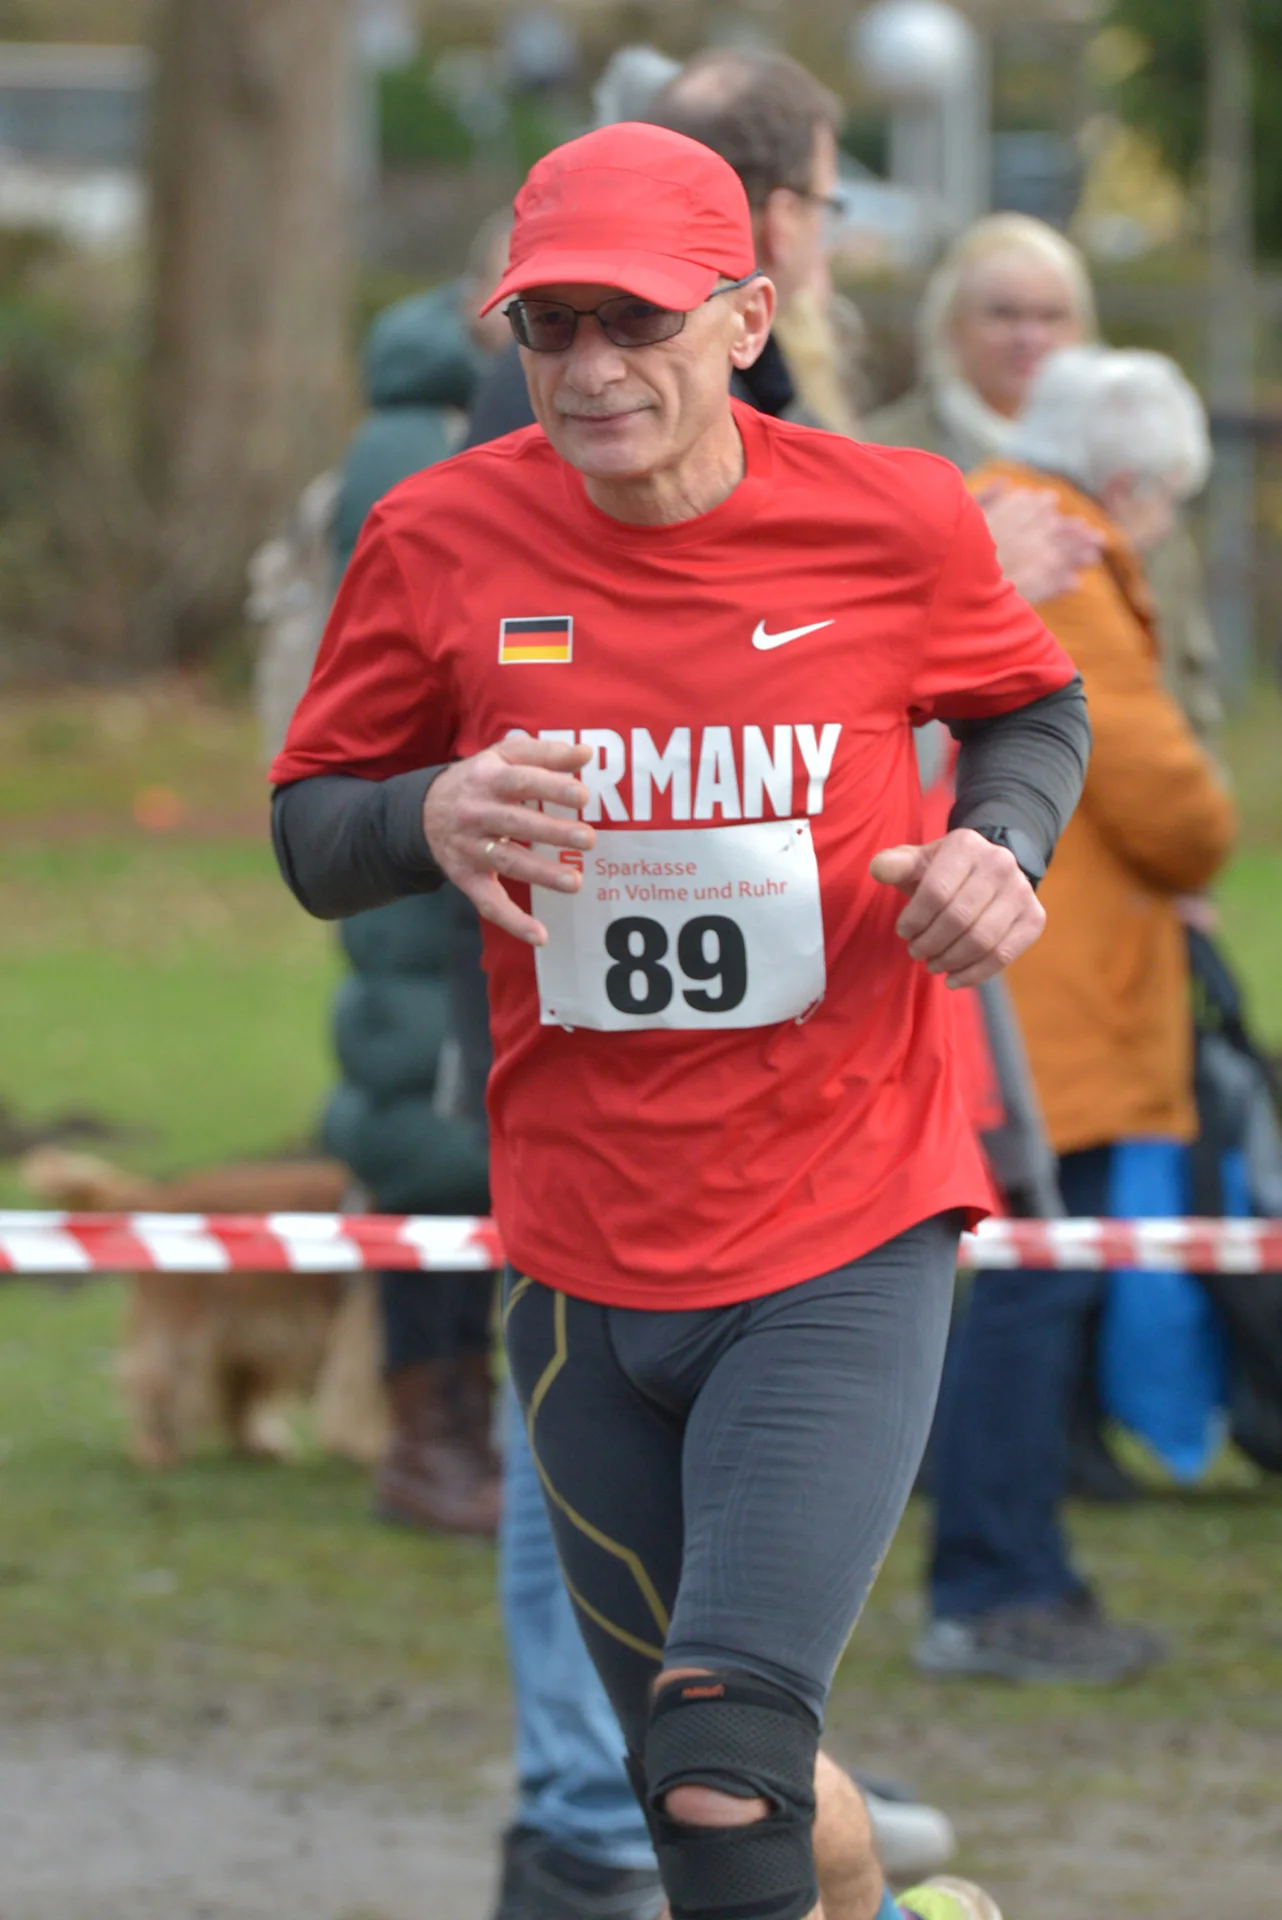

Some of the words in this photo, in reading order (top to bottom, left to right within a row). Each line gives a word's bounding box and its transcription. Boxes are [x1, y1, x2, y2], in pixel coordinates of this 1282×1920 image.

[503, 723, 842, 822] RMANY
[595, 857, 697, 878] Sparkasse
[596, 886, 620, 901] an
[624, 883, 688, 902] Volme
[693, 881, 733, 901] und
[738, 877, 788, 898] Ruhr
[604, 914, 748, 1015] 89
